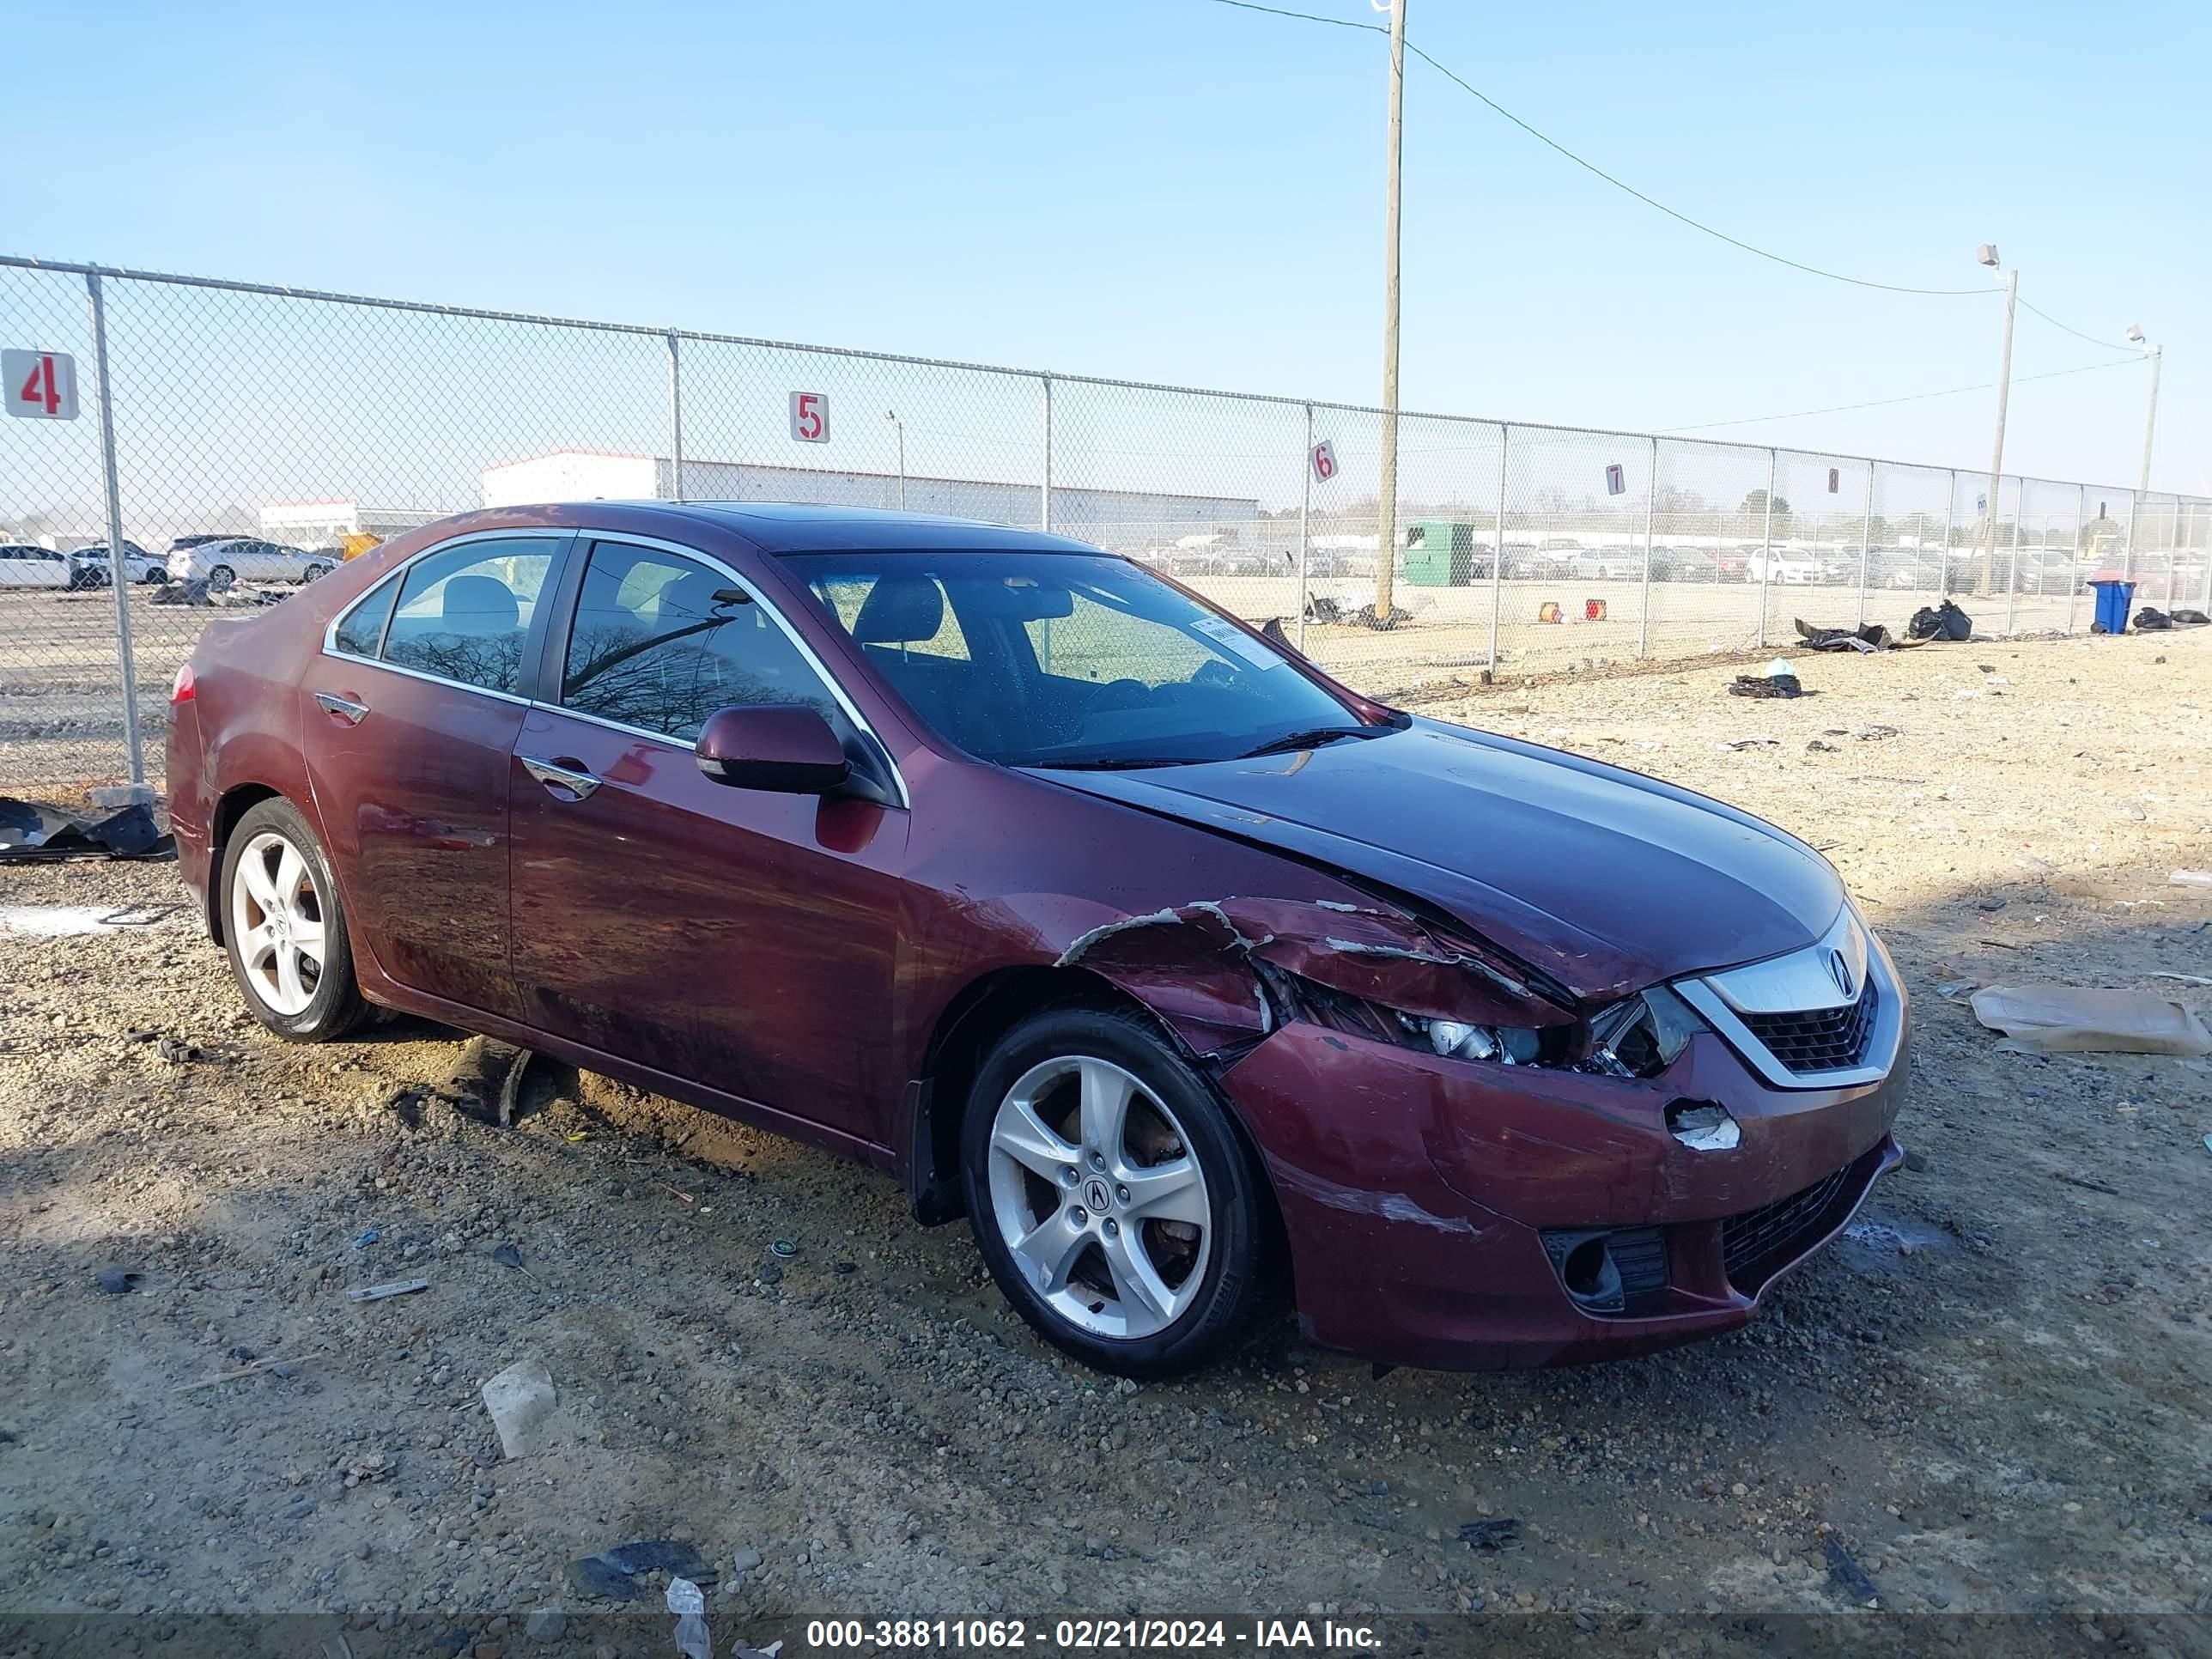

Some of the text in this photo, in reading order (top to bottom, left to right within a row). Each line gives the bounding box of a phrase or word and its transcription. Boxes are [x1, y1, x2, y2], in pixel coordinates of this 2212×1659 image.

[21, 356, 61, 415] 4
[799, 394, 822, 439] 5
[1316, 446, 1333, 478] 6
[1610, 466, 1619, 495] 7
